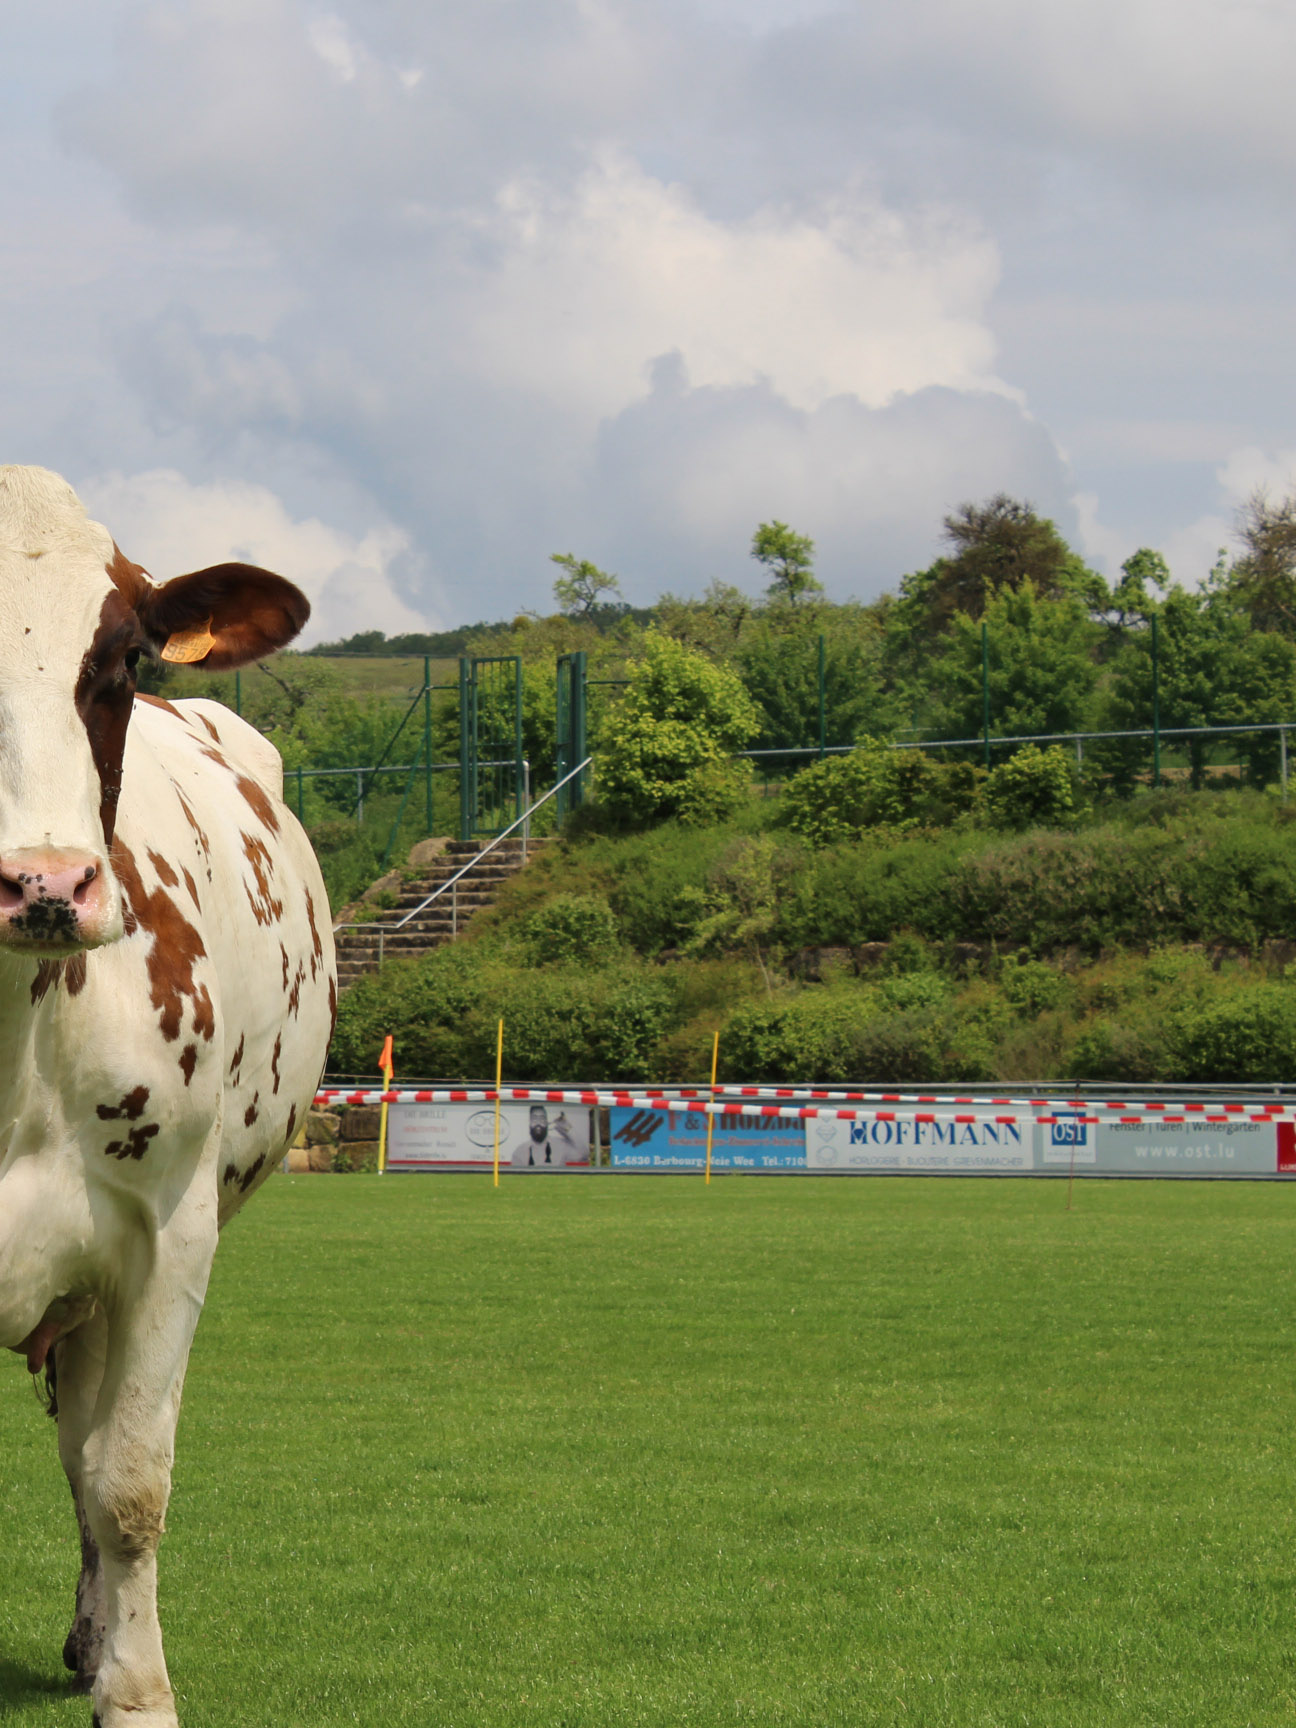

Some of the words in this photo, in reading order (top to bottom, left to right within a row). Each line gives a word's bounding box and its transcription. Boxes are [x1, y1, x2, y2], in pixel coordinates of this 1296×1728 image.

[848, 1119, 1022, 1146] HOFFMANN
[1053, 1122, 1085, 1142] OST
[1109, 1121, 1146, 1132] Fenster
[1135, 1143, 1235, 1159] www.ost.lu
